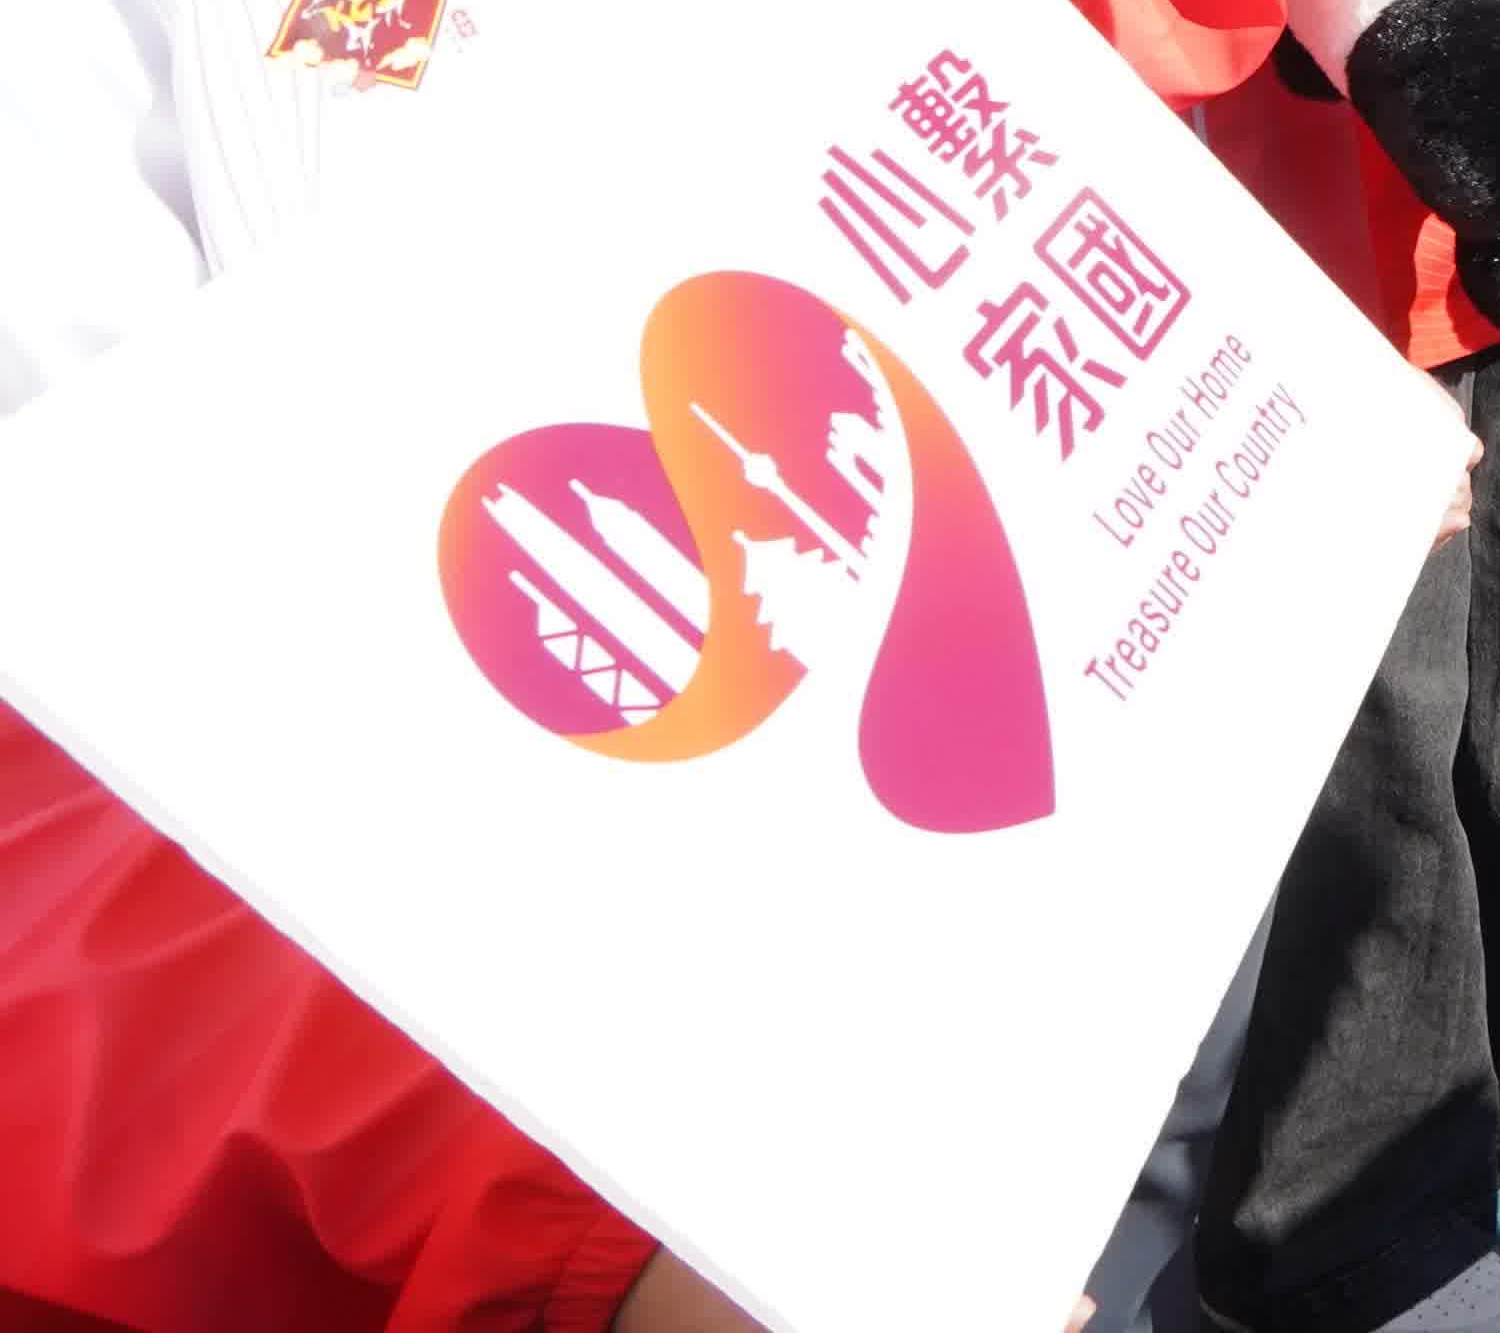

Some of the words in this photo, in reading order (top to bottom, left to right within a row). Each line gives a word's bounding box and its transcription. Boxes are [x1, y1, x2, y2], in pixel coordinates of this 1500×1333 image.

[817, 47, 1061, 306] 心繫
[961, 184, 1194, 463] 家國
[1090, 462, 1170, 551] Love
[1150, 406, 1203, 474] Our
[1186, 329, 1256, 416] Home
[1193, 486, 1240, 557] Our
[1213, 380, 1309, 502] Country
[1082, 553, 1203, 704] Treasure
